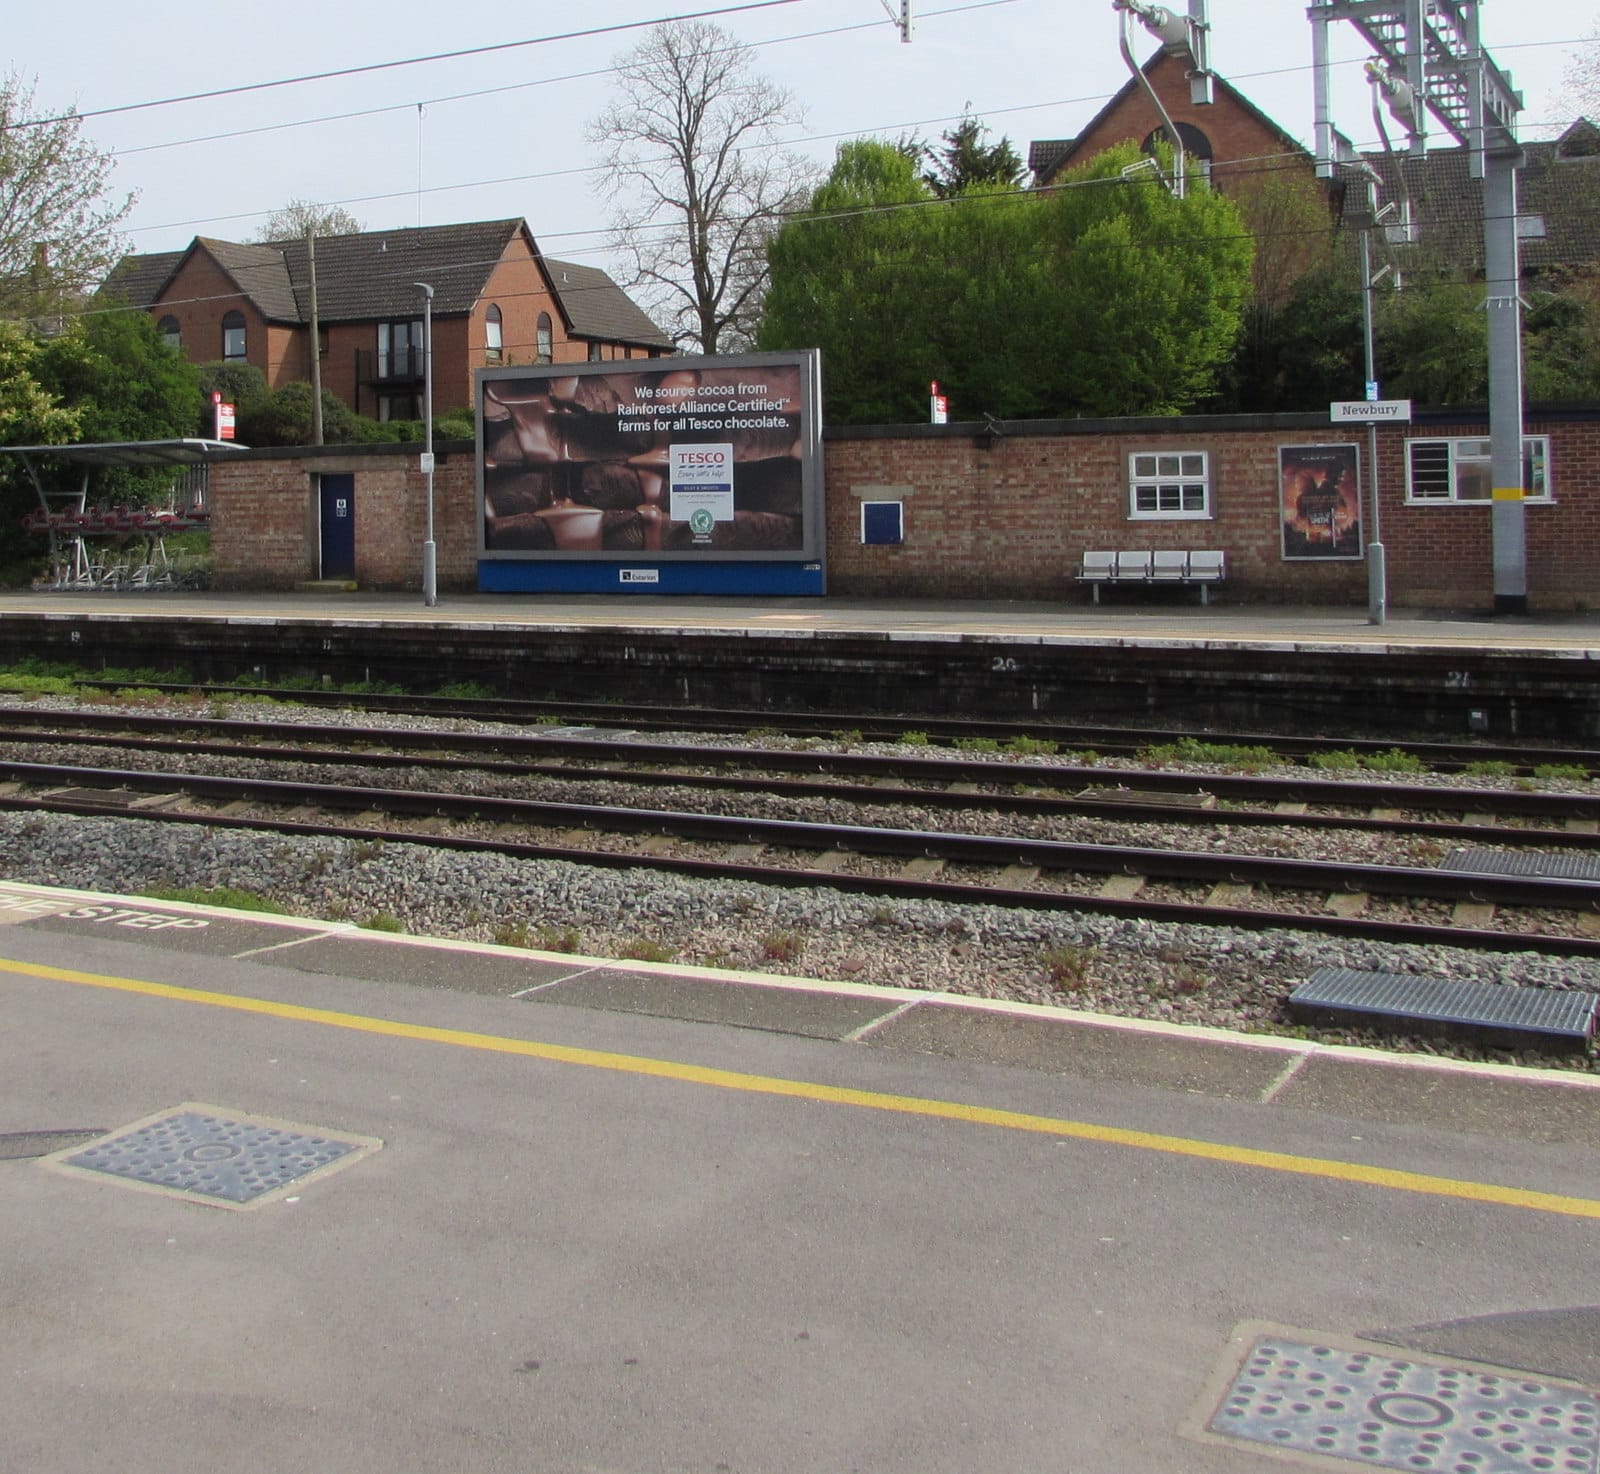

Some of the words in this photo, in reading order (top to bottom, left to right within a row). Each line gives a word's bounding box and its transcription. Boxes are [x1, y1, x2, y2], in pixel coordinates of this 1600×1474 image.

[635, 386, 653, 398] We
[655, 386, 695, 398] source
[698, 384, 735, 396] cocoa
[738, 382, 767, 395] from
[617, 402, 677, 416] Rainforest
[679, 400, 726, 414] Alliance
[1342, 405, 1398, 416] Newbury
[618, 419, 651, 432] farms
[654, 418, 671, 431] for
[673, 418, 686, 430] all
[688, 417, 722, 430] Tesco
[724, 415, 790, 429] chocolate.
[678, 452, 725, 464] TESCO
[60, 906, 209, 929] STEP
